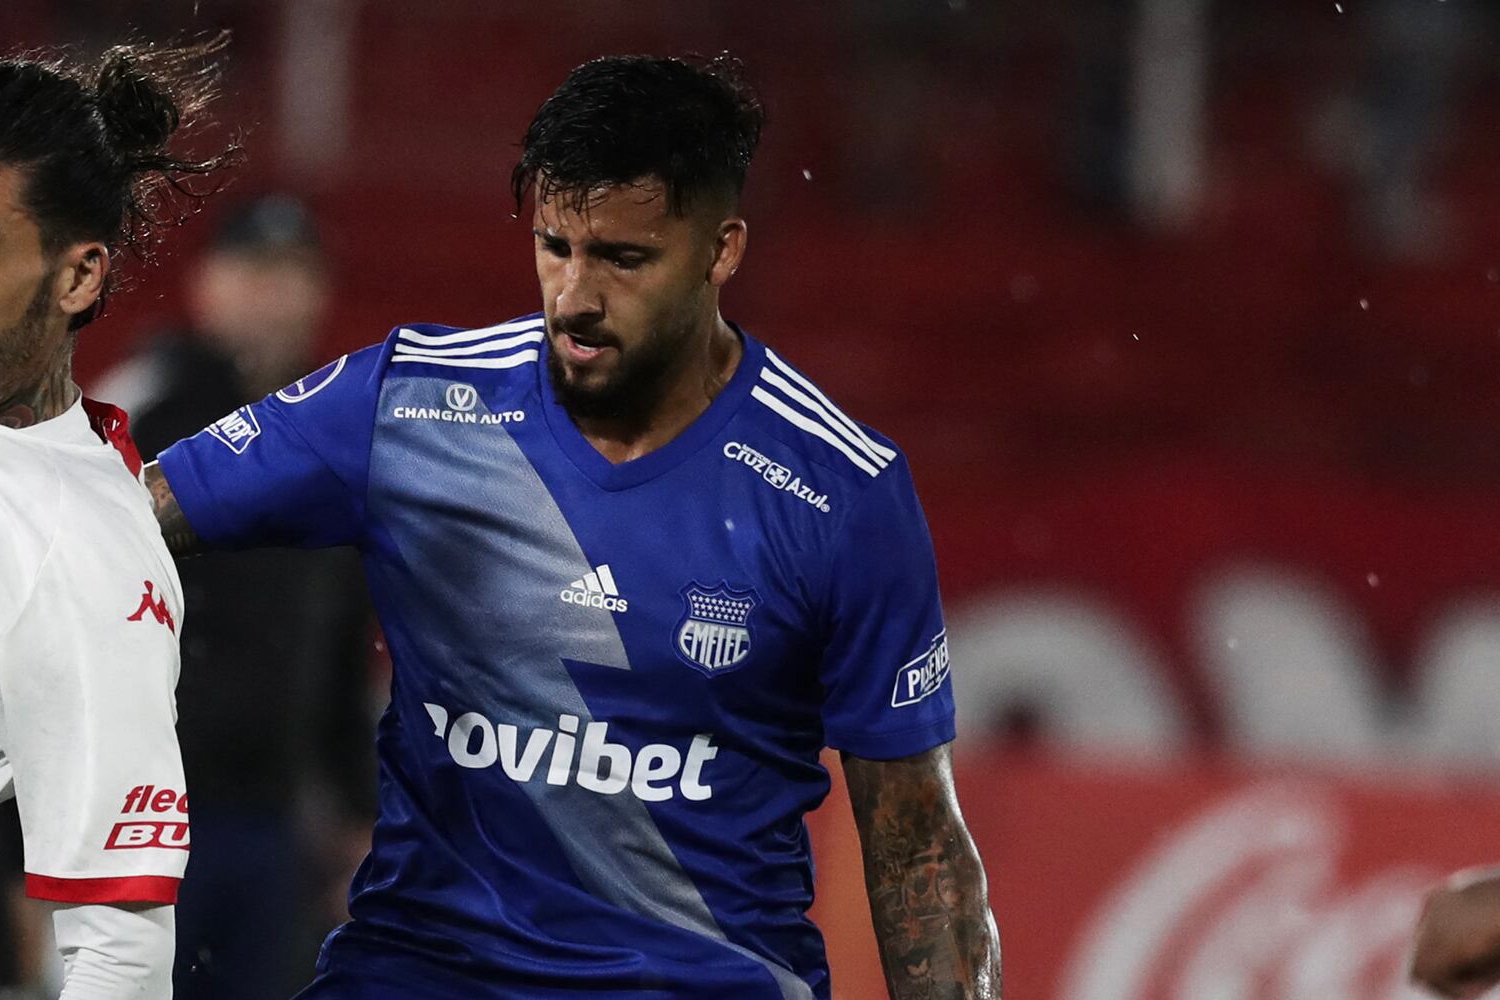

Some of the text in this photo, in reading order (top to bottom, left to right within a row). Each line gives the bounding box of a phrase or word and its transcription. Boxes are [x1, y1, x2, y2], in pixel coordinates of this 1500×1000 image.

[393, 407, 526, 425] CHANGAN AUTO
[723, 441, 766, 474] Cruz
[560, 589, 628, 613] adidas
[678, 619, 751, 669] EMELEC
